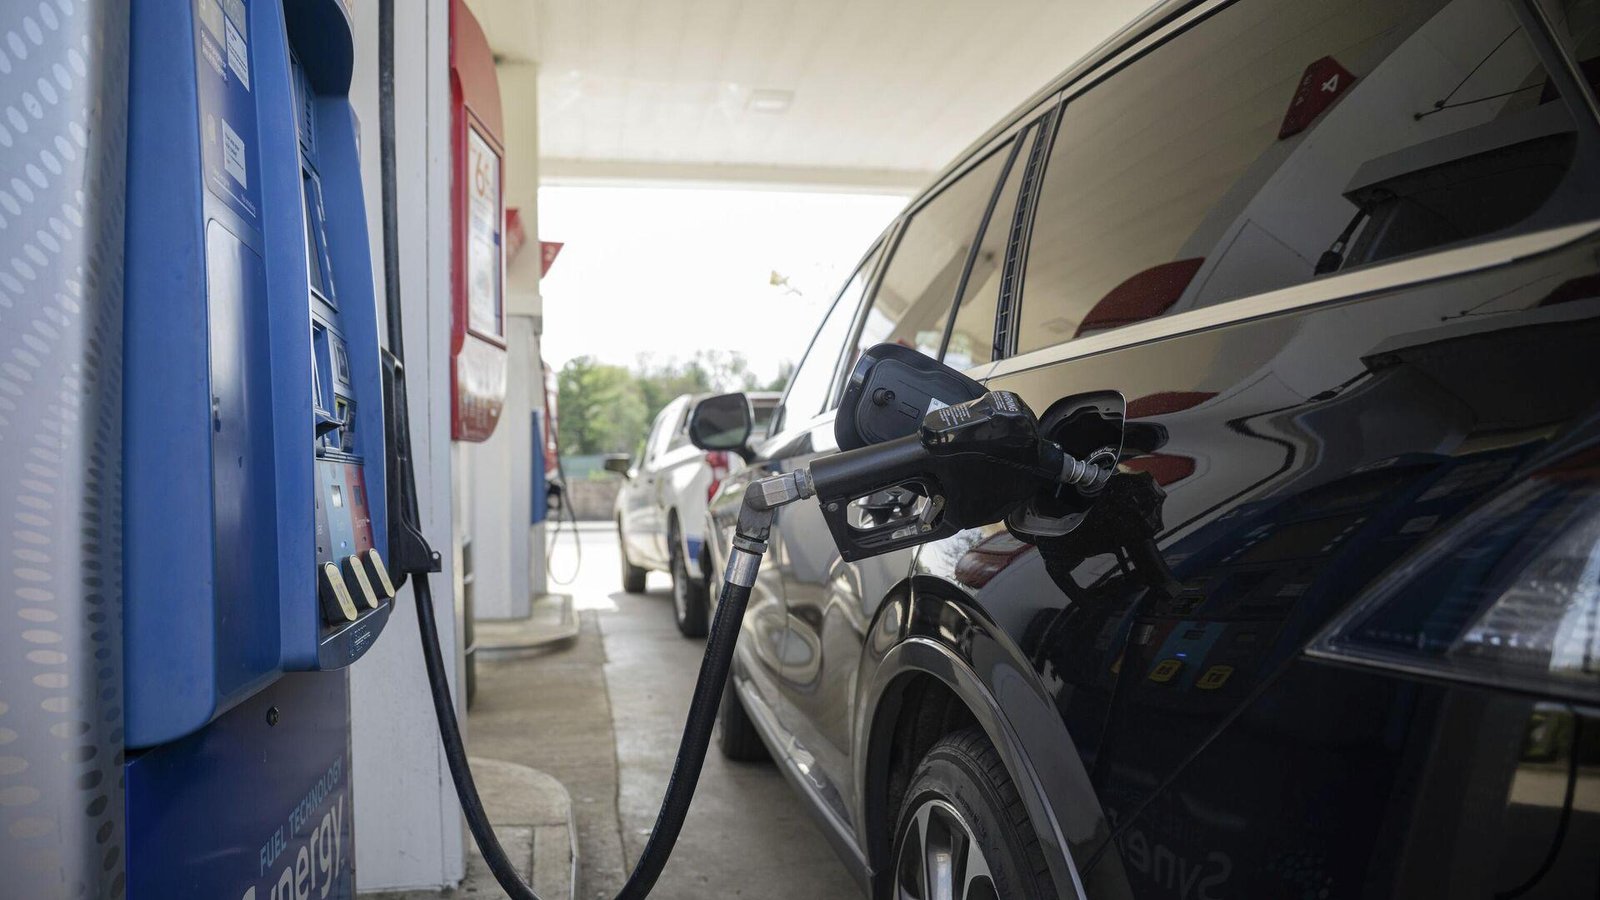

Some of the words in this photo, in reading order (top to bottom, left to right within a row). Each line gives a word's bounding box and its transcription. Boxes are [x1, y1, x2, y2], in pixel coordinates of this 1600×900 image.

[241, 795, 343, 900] nergy
[260, 825, 286, 876] FUEL
[289, 755, 342, 839] TECHNOLOGY
